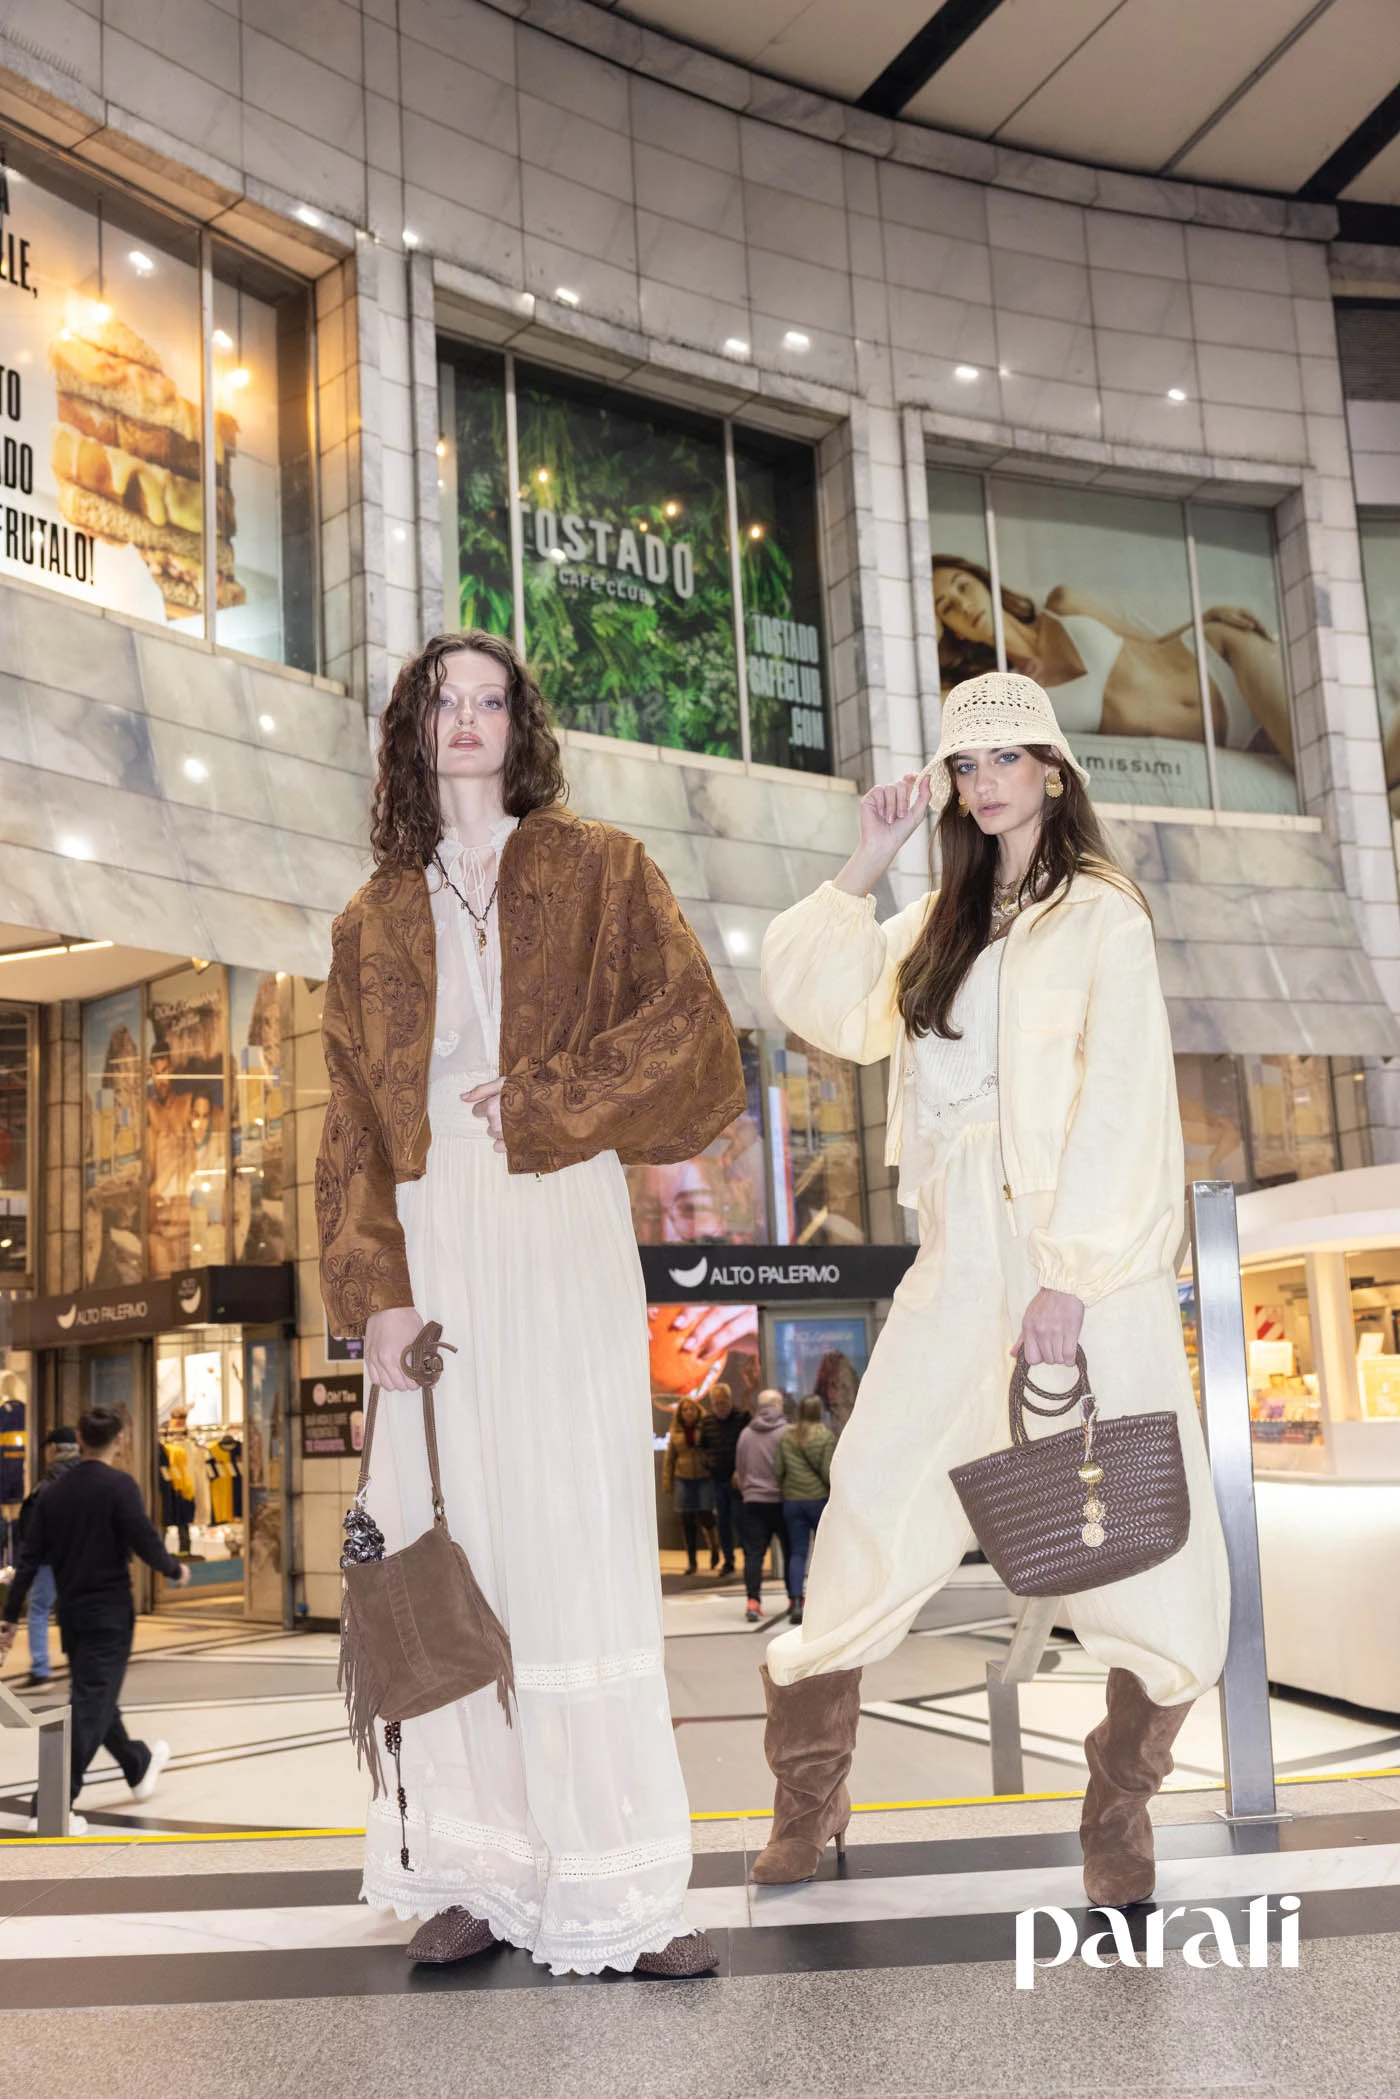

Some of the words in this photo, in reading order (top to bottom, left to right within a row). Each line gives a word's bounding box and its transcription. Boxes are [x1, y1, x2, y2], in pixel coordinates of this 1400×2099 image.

[0, 434, 33, 495] DO
[0, 504, 95, 585] RUTALO!
[606, 580, 651, 604] CLUB
[753, 613, 819, 664] TOSTADO
[710, 1266, 755, 1285] ALTO
[758, 1264, 840, 1285] PALERMO
[76, 1308, 99, 1326] ALTO
[101, 1301, 148, 1321] PALERMO
